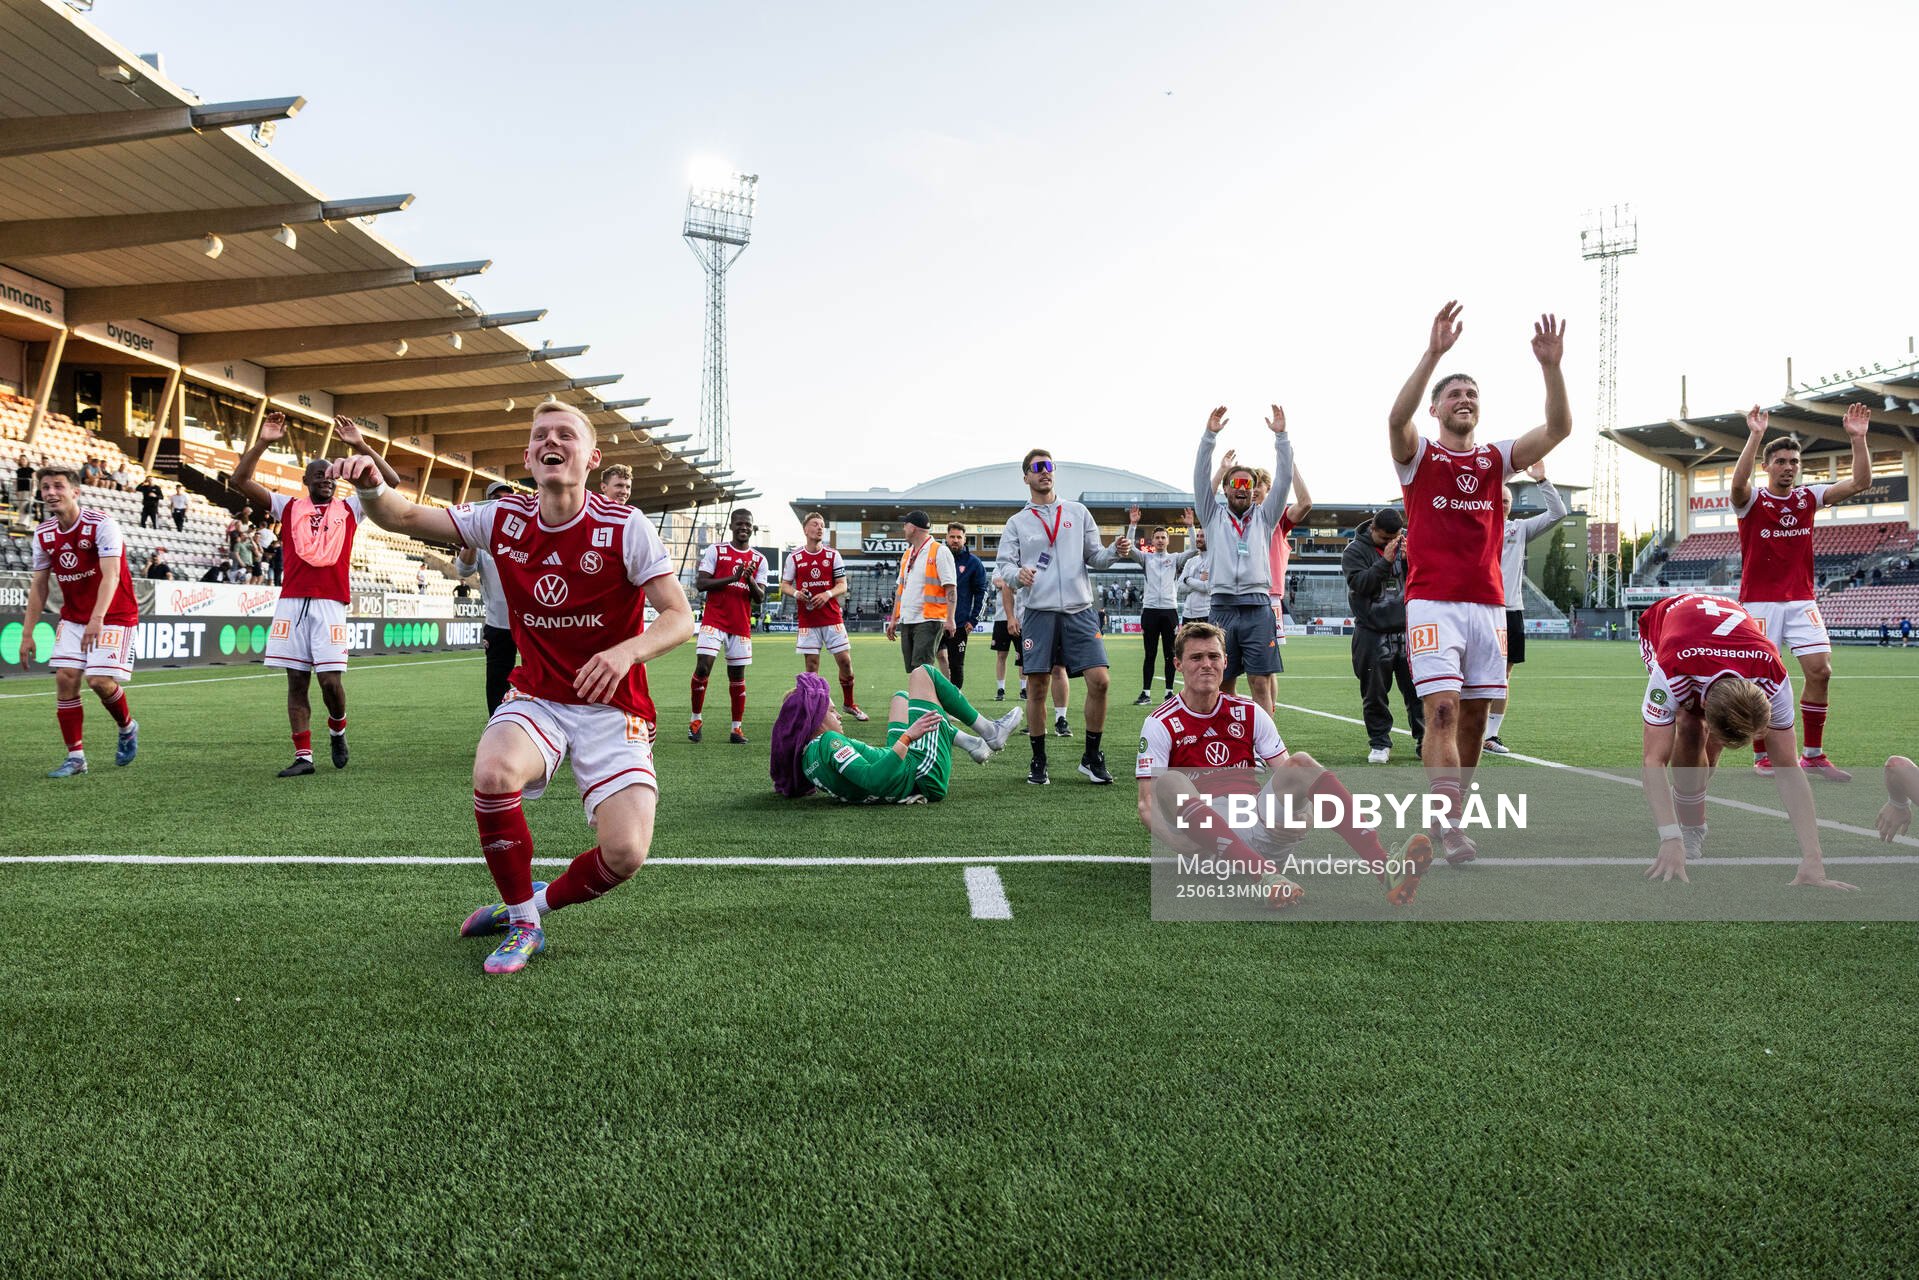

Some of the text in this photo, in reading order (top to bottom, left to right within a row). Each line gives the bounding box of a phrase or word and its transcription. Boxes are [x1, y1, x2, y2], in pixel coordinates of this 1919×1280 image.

[107, 322, 154, 350] bygger
[224, 365, 233, 379] vi
[298, 393, 311, 407] ett
[1690, 496, 1729, 509] MAXI
[1773, 527, 1811, 538] SANDVIK
[864, 539, 910, 551] VÄSTR
[57, 568, 97, 582] SANDVIK
[523, 613, 605, 629] SANDVIK
[134, 622, 206, 659] NIBET
[347, 623, 375, 649] BET
[446, 622, 483, 645] UNIBET
